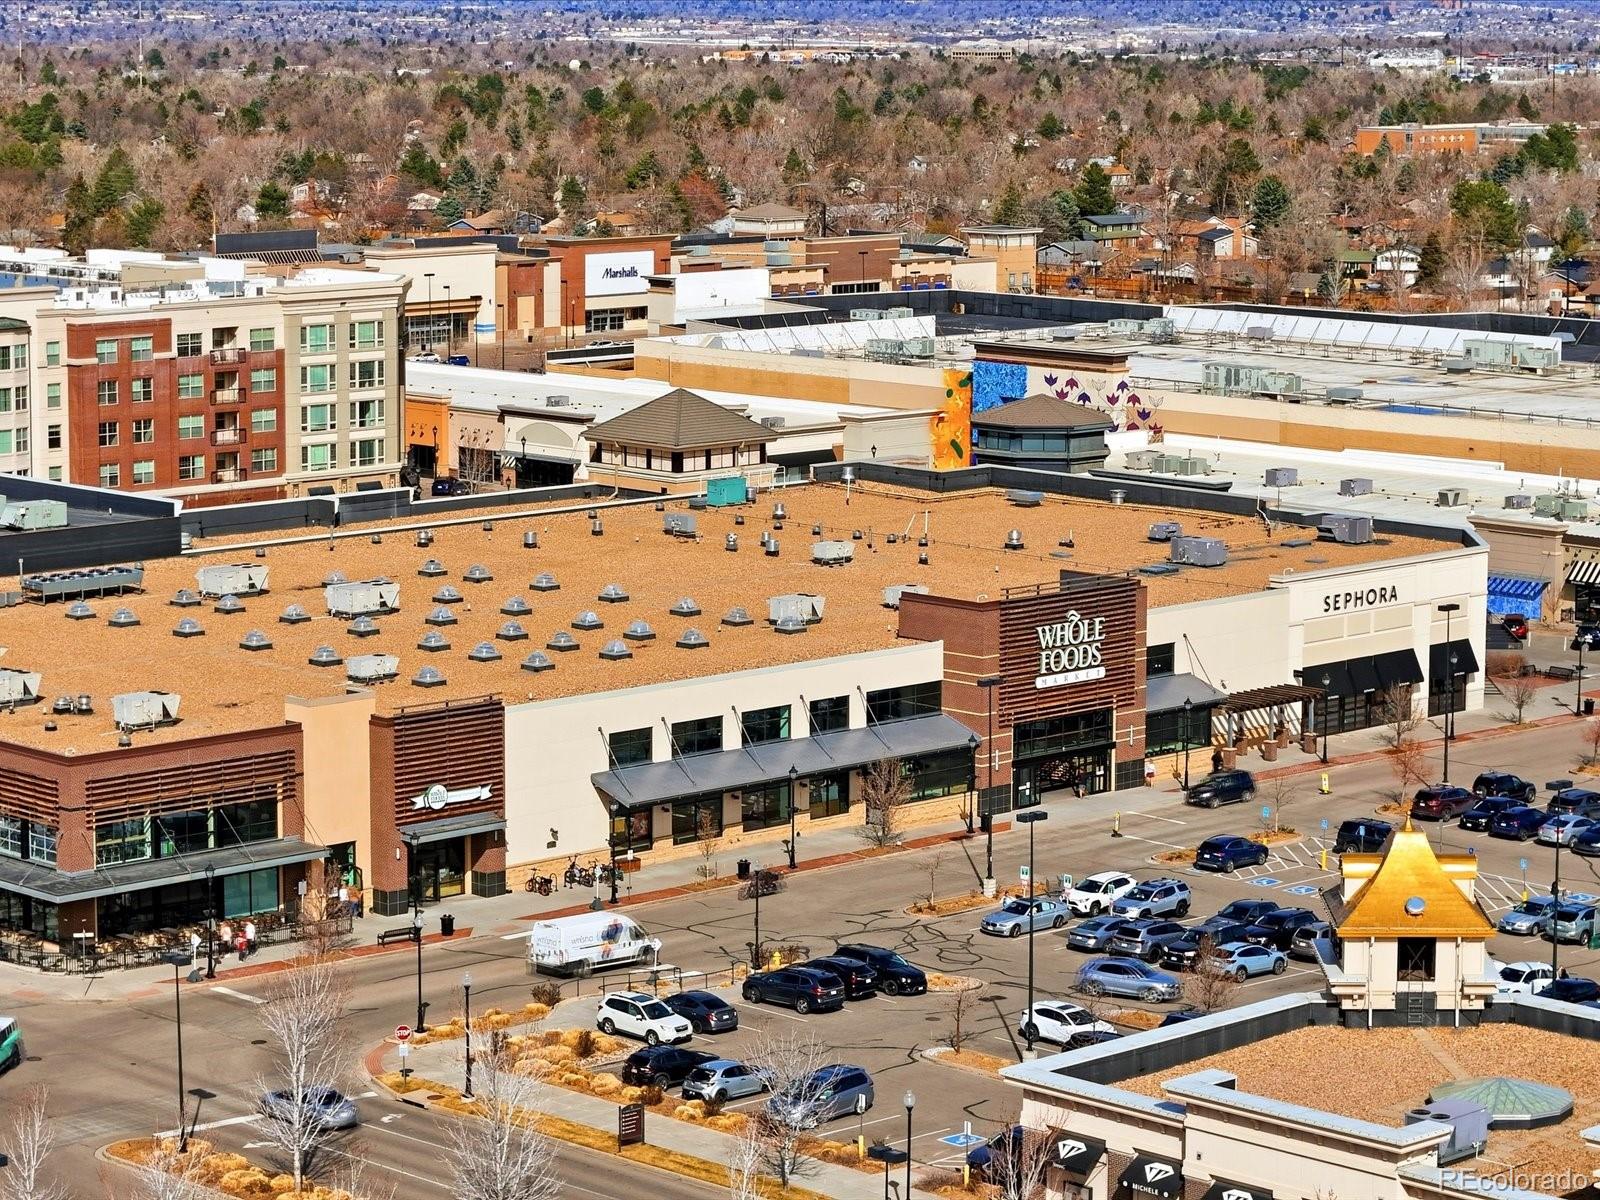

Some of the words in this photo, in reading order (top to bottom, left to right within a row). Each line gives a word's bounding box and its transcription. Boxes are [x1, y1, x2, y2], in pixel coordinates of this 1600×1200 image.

[602, 266, 638, 279] Marshalls
[1323, 585, 1398, 612] SEPHORA
[1035, 610, 1106, 649] WHOLE
[1040, 642, 1102, 674] FOODS
[1041, 669, 1101, 686] MARKET
[1132, 1182, 1159, 1195] MICHELE
